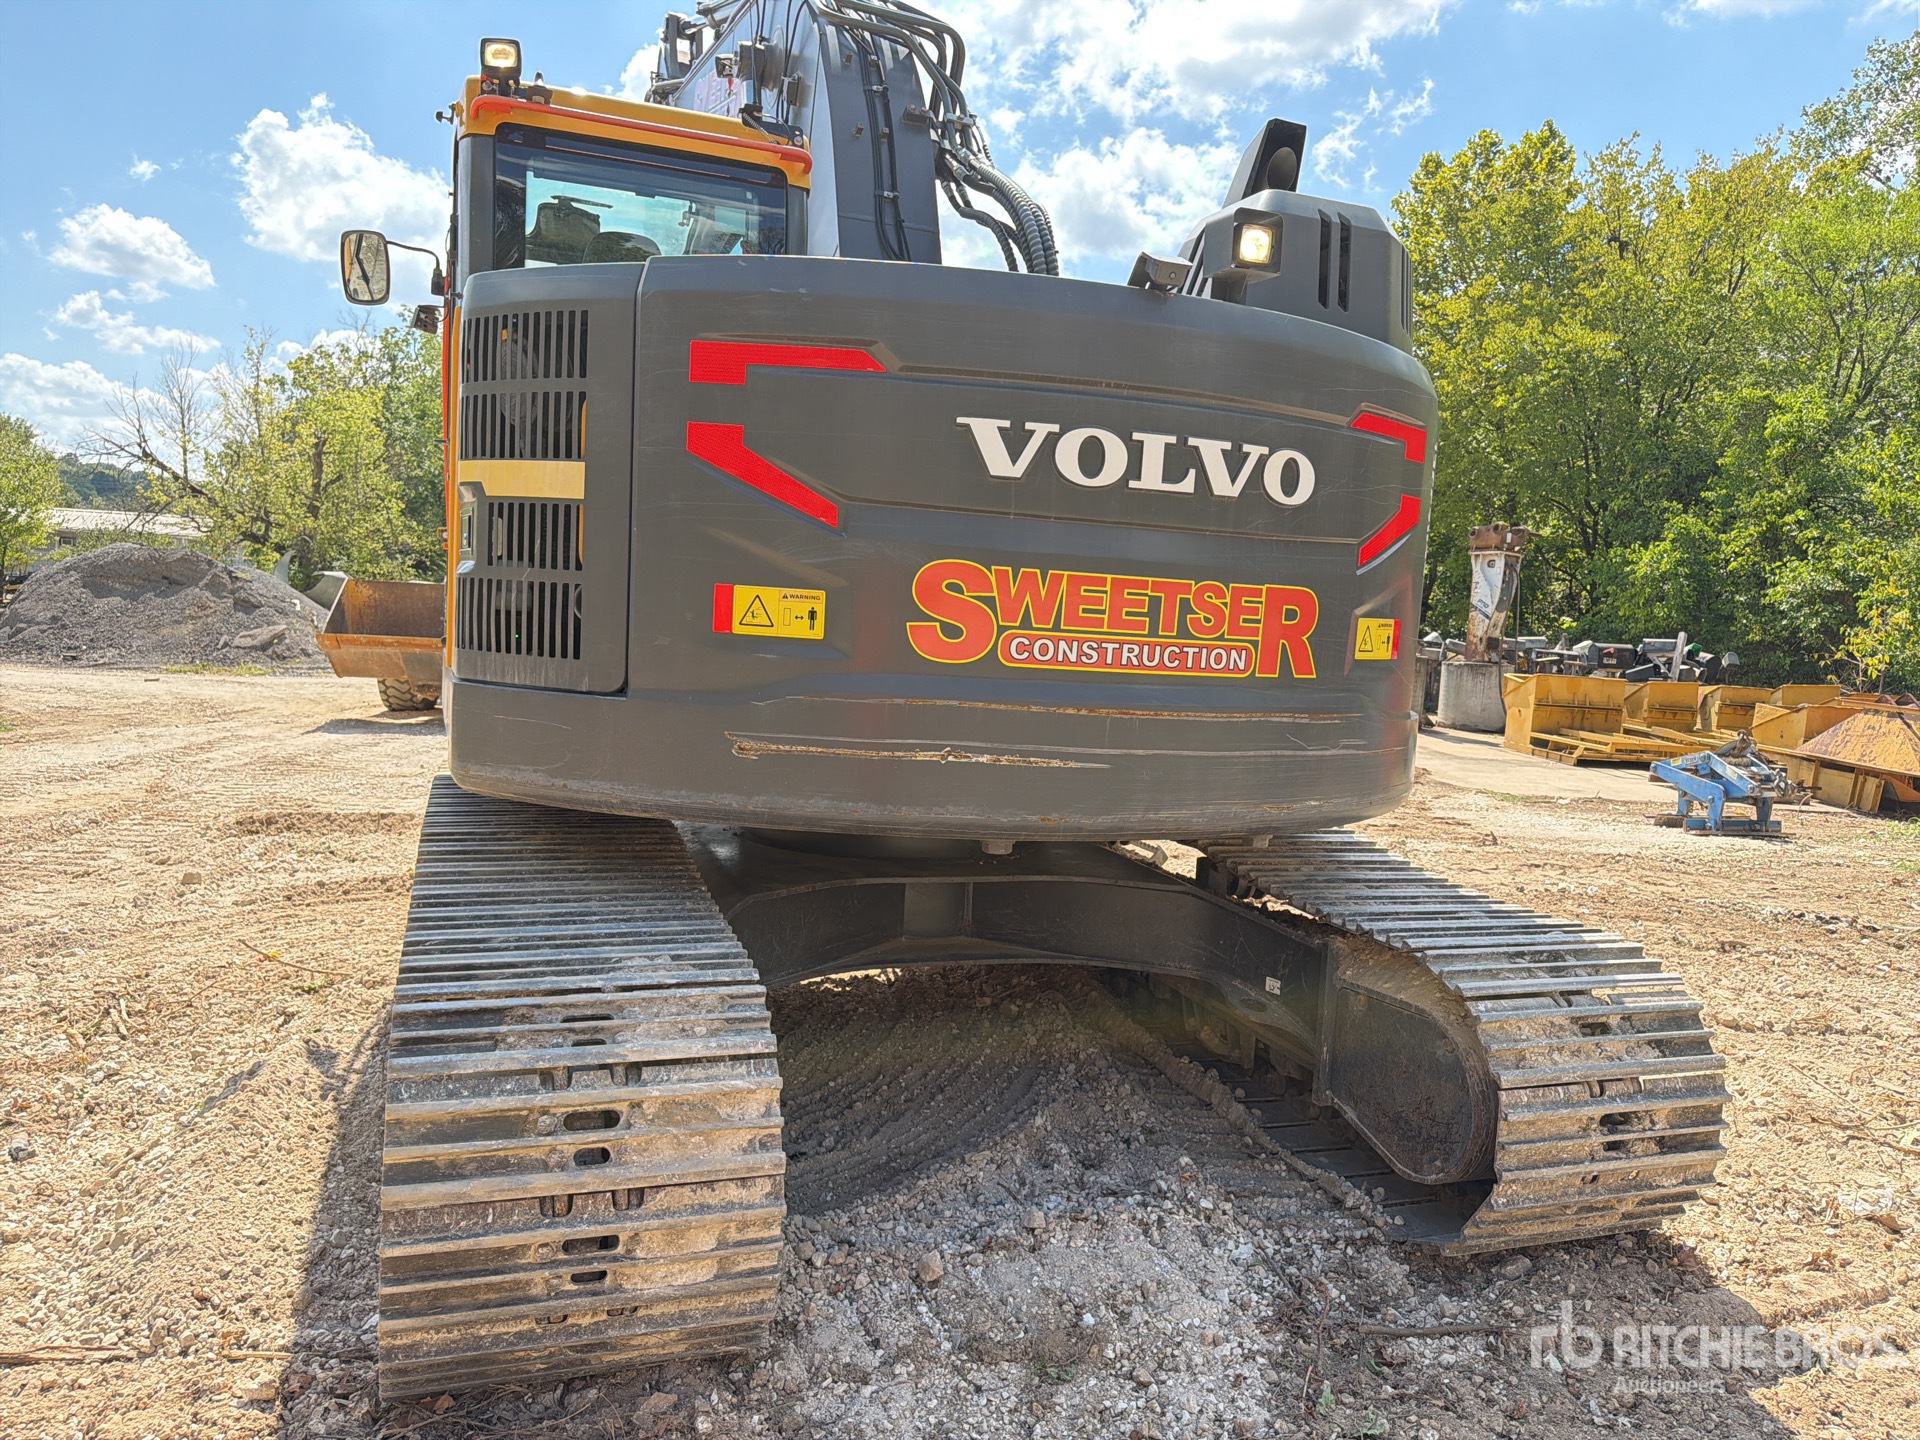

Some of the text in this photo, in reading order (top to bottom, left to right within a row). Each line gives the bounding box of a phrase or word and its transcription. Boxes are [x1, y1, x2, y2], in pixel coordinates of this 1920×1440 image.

[956, 416, 1316, 506] VOLVO
[789, 593, 821, 601] WARNING
[906, 559, 1319, 679] SWEETSER
[1008, 636, 1248, 672] CONSTRUCTION
